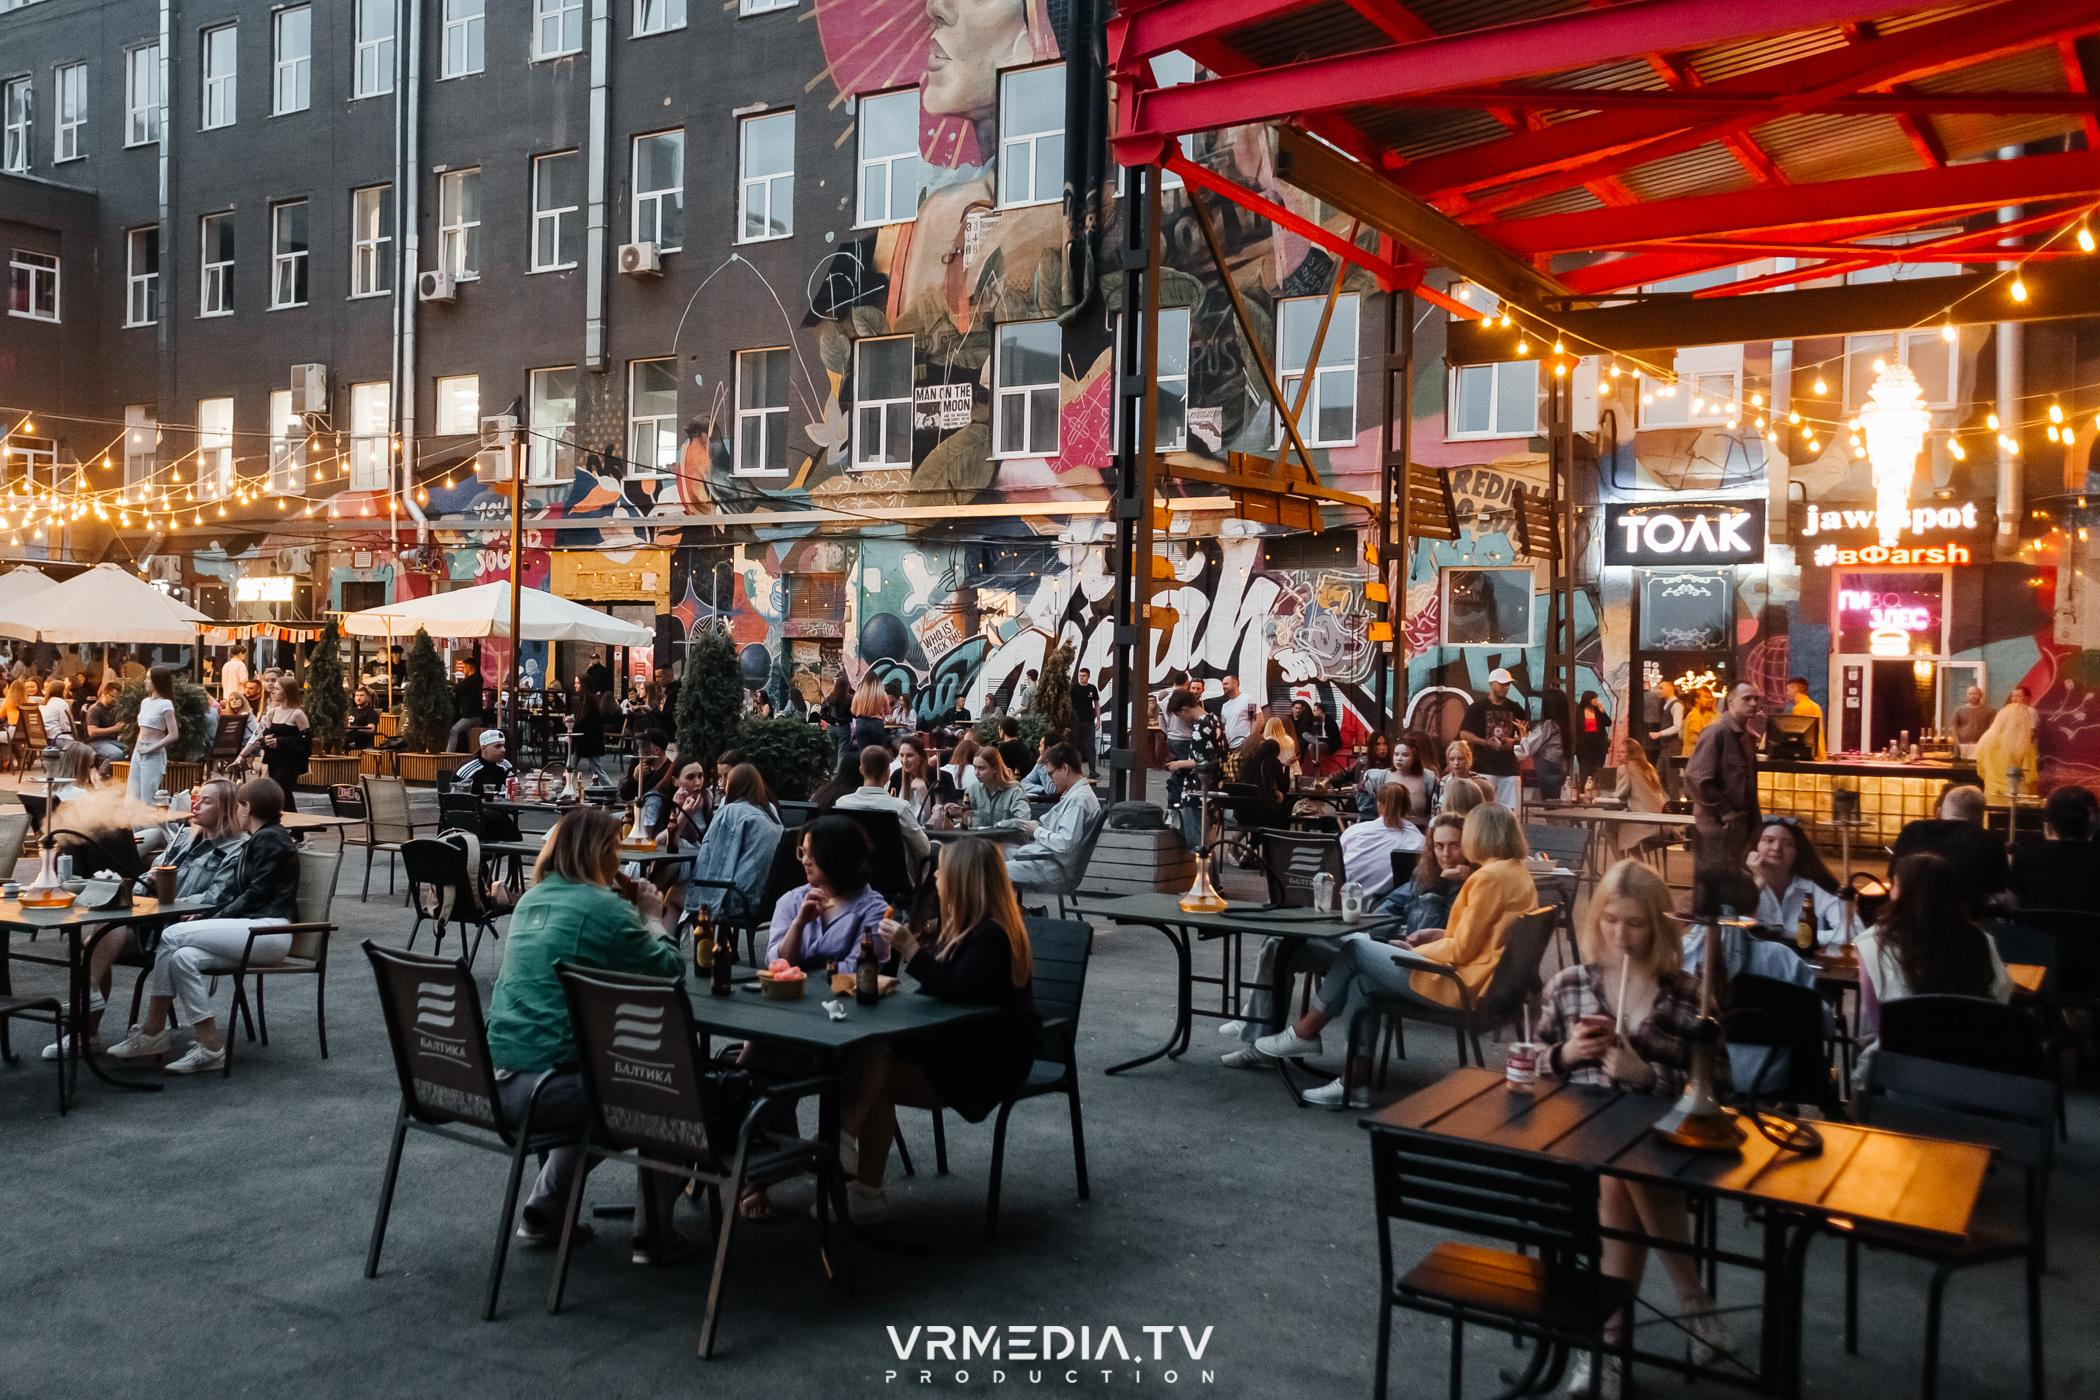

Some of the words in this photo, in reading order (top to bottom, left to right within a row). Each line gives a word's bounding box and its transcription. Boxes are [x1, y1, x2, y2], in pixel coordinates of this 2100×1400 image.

[916, 388, 937, 402] MAN
[955, 384, 971, 398] THE
[943, 398, 970, 412] MOON
[922, 628, 943, 649] WHO
[941, 622, 952, 636] IS
[420, 1037, 466, 1058] БАЛТИКА
[614, 1061, 672, 1085] БАЛТИКА
